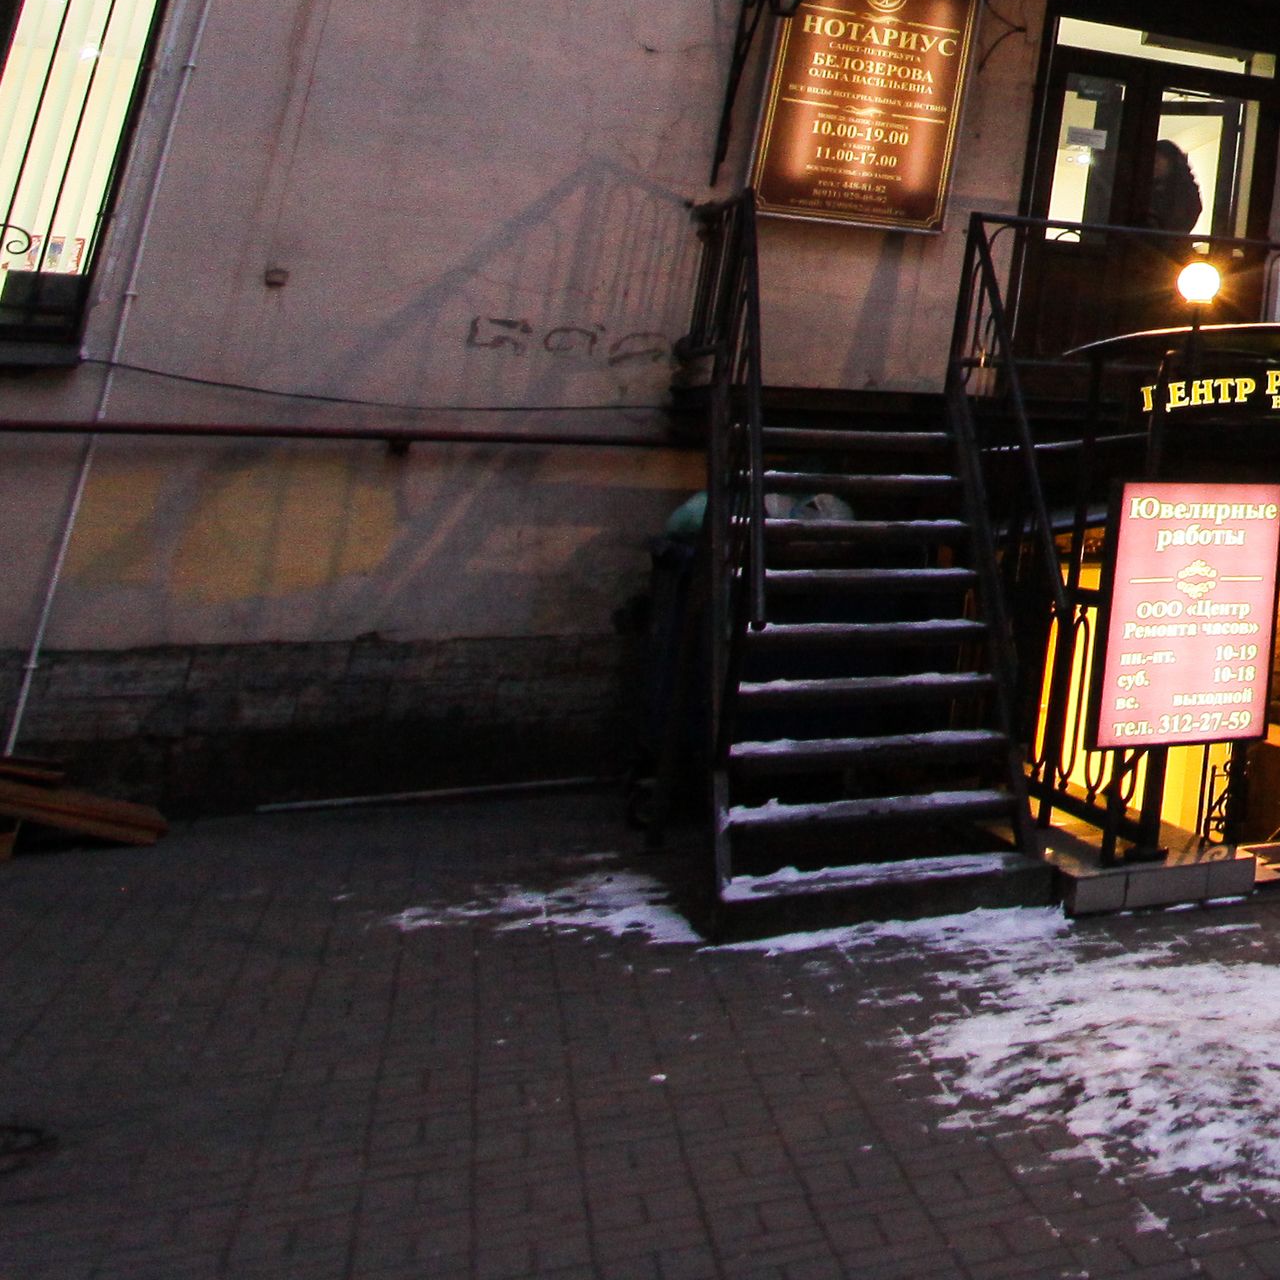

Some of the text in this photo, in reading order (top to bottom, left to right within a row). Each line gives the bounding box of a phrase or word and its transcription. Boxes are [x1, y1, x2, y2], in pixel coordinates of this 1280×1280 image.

[803, 14, 957, 56] НОТАРИУС
[812, 52, 934, 83] БЕЛОЗЕРОВА
[808, 68, 933, 95] ОЛЬГА ВАСИЛЬЕВНА
[812, 120, 909, 145] 10.00-19.00
[815, 147, 897, 168] 11.00-17.00
[1129, 497, 1279, 525] Ювелирные
[1156, 524, 1246, 552] работы
[1136, 599, 1250, 619] ООО «Центр
[1123, 621, 1259, 640] Ремонта часов»
[1120, 644, 1258, 666] пн.-пт. 10-19
[1117, 666, 1256, 691] суб. 10-18
[1115, 688, 1254, 710] вс. выходной
[1113, 711, 1251, 737] тел. 312-27-59
